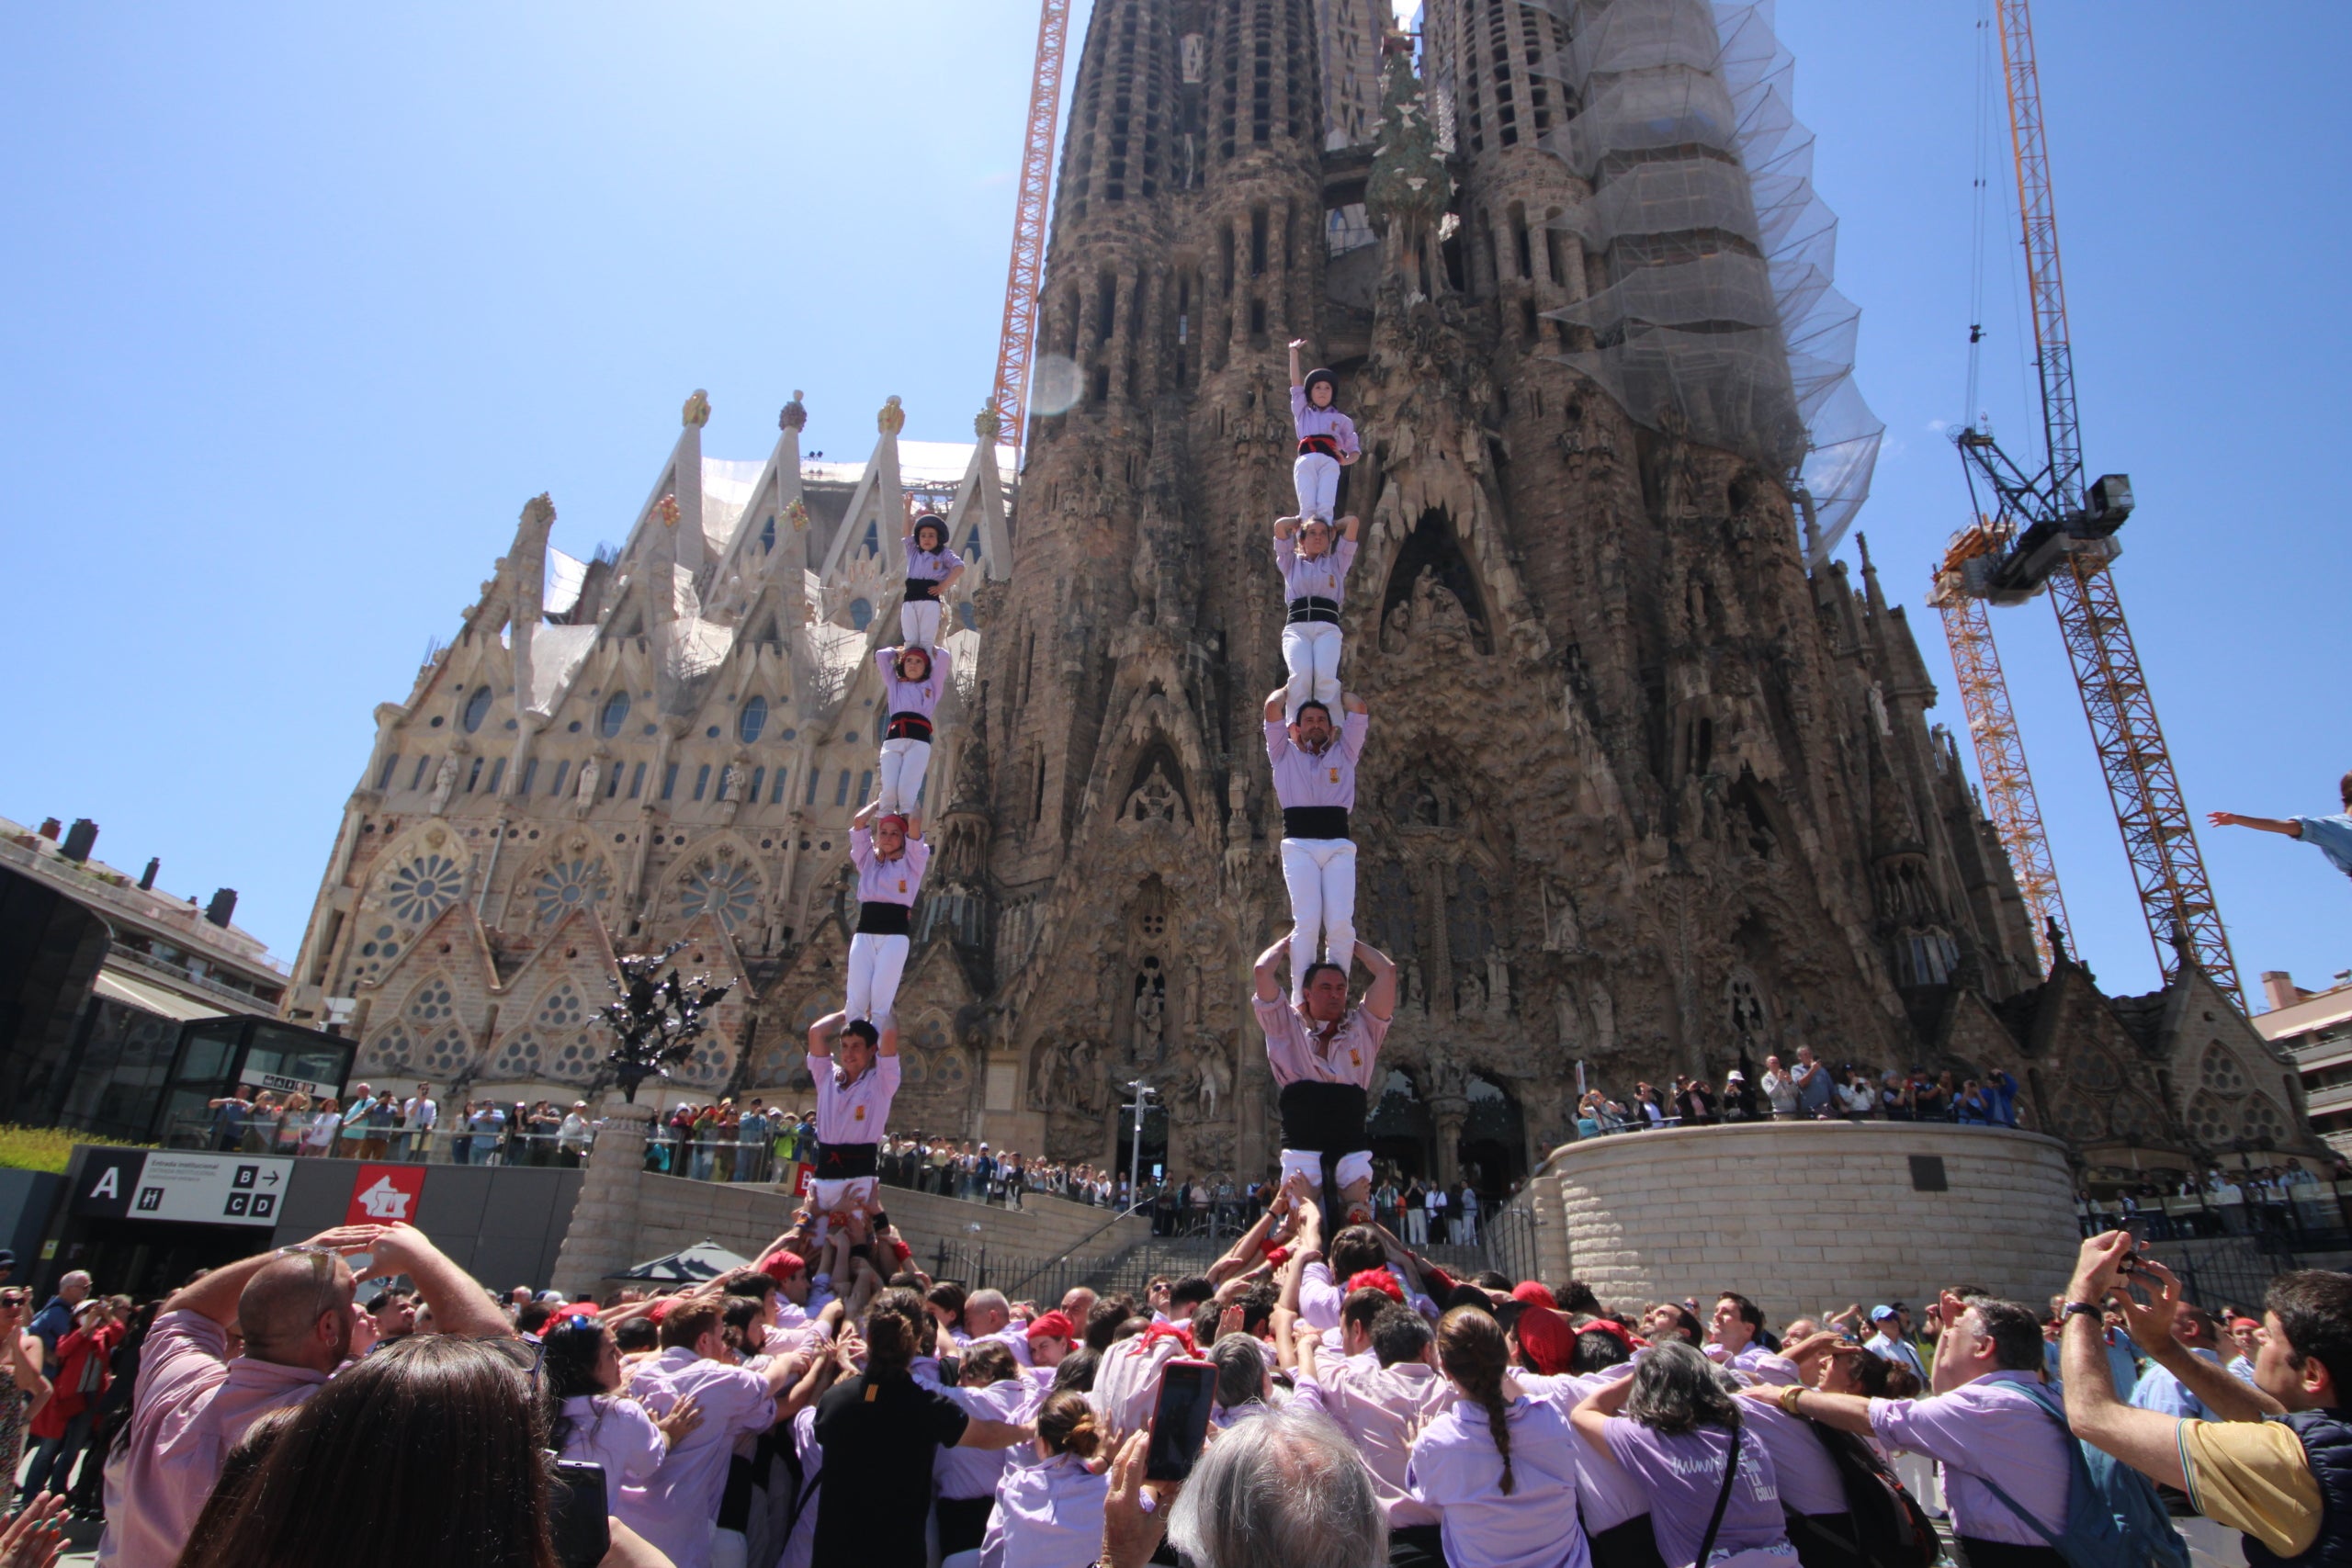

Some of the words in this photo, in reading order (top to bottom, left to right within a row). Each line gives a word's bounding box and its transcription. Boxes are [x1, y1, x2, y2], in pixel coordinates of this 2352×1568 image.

[90, 1167, 119, 1199] A
[240, 1170, 252, 1184] B
[232, 1198, 243, 1211] C
[256, 1199, 268, 1212] D
